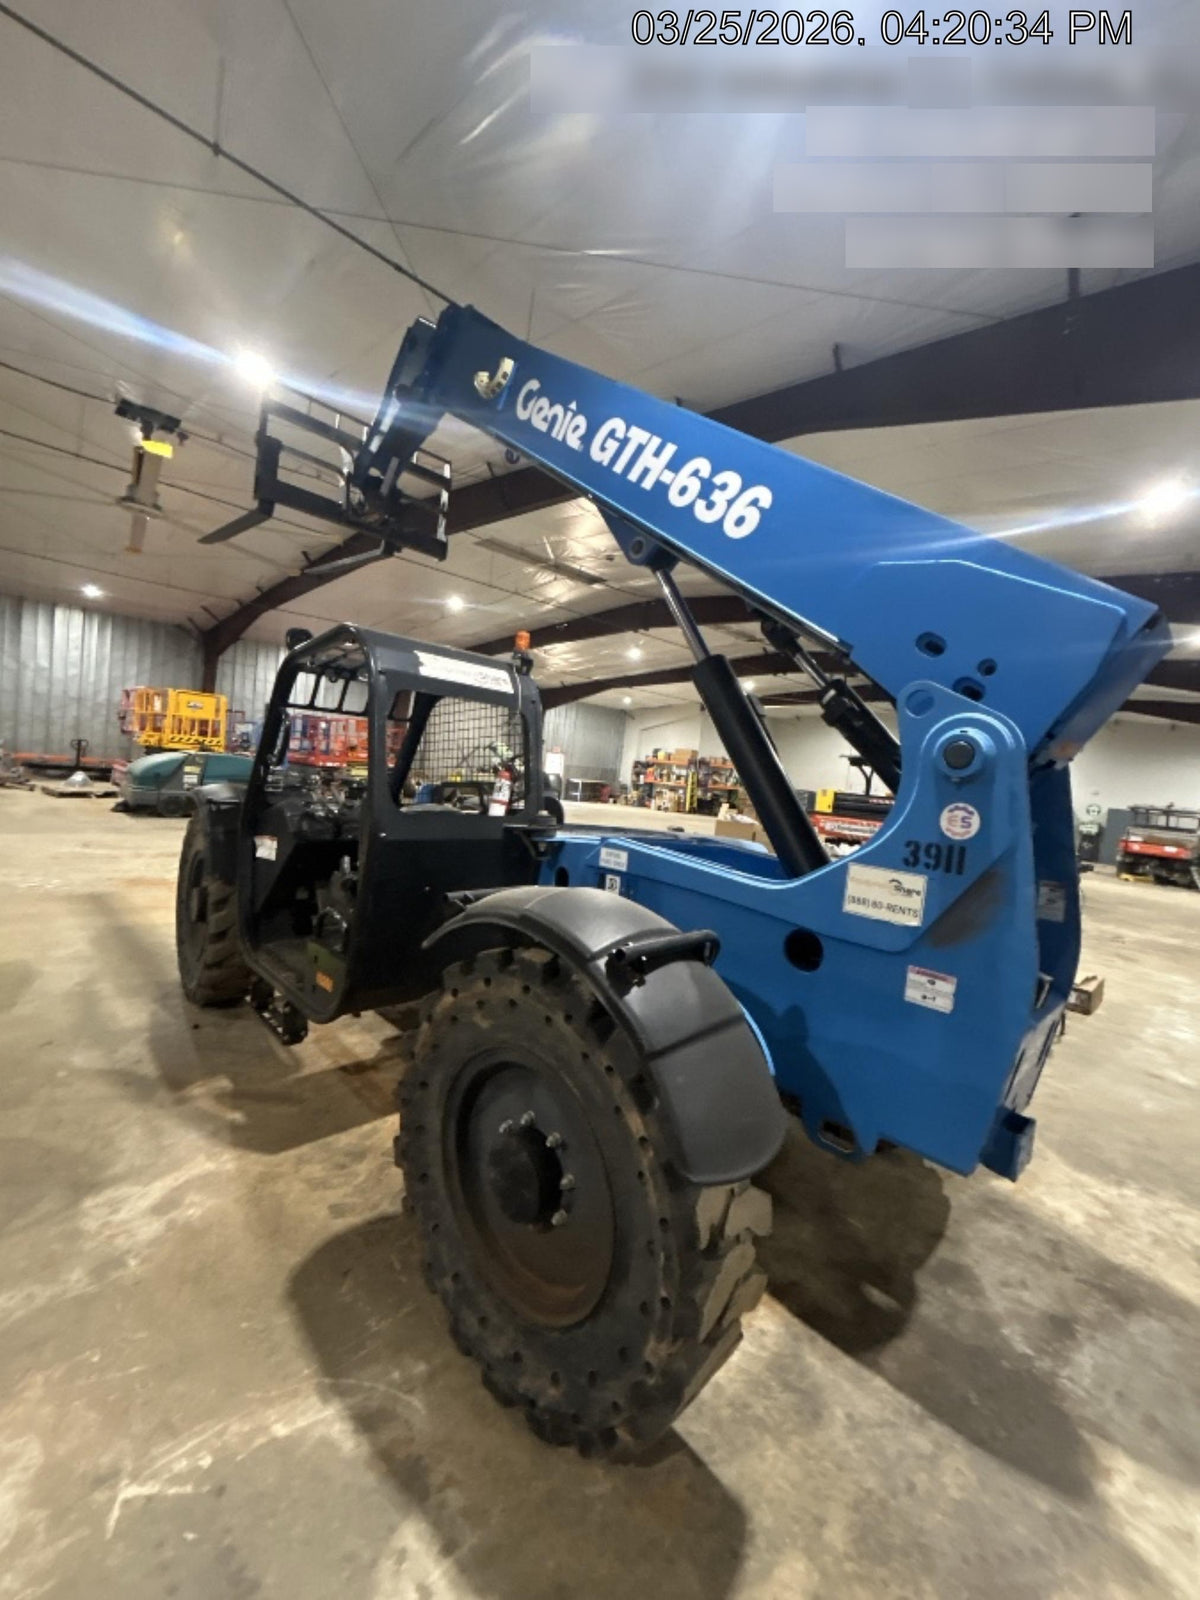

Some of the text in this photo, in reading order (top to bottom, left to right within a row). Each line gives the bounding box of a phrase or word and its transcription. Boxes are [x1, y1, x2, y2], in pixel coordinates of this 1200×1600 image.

[516, 378, 773, 539] Genie GTH-636
[903, 840, 966, 875] 3911
